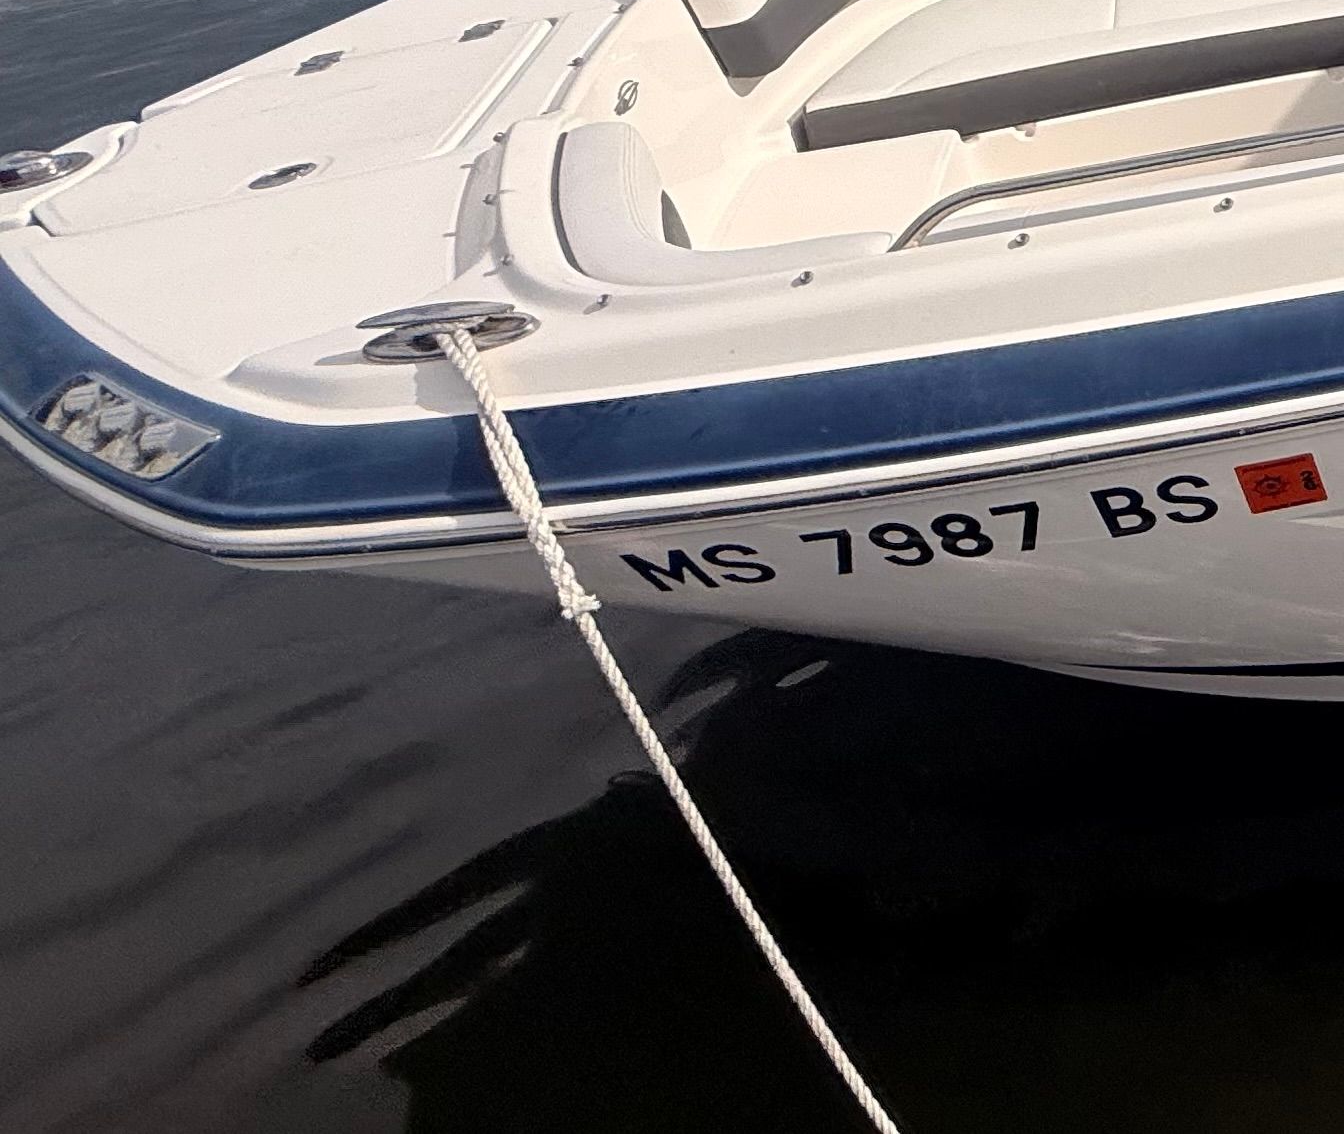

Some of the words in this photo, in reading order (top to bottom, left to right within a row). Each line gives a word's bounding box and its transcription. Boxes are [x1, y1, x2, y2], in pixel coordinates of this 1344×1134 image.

[619, 543, 777, 592] MS
[798, 501, 1040, 575] 7987
[1089, 474, 1219, 538] BS
